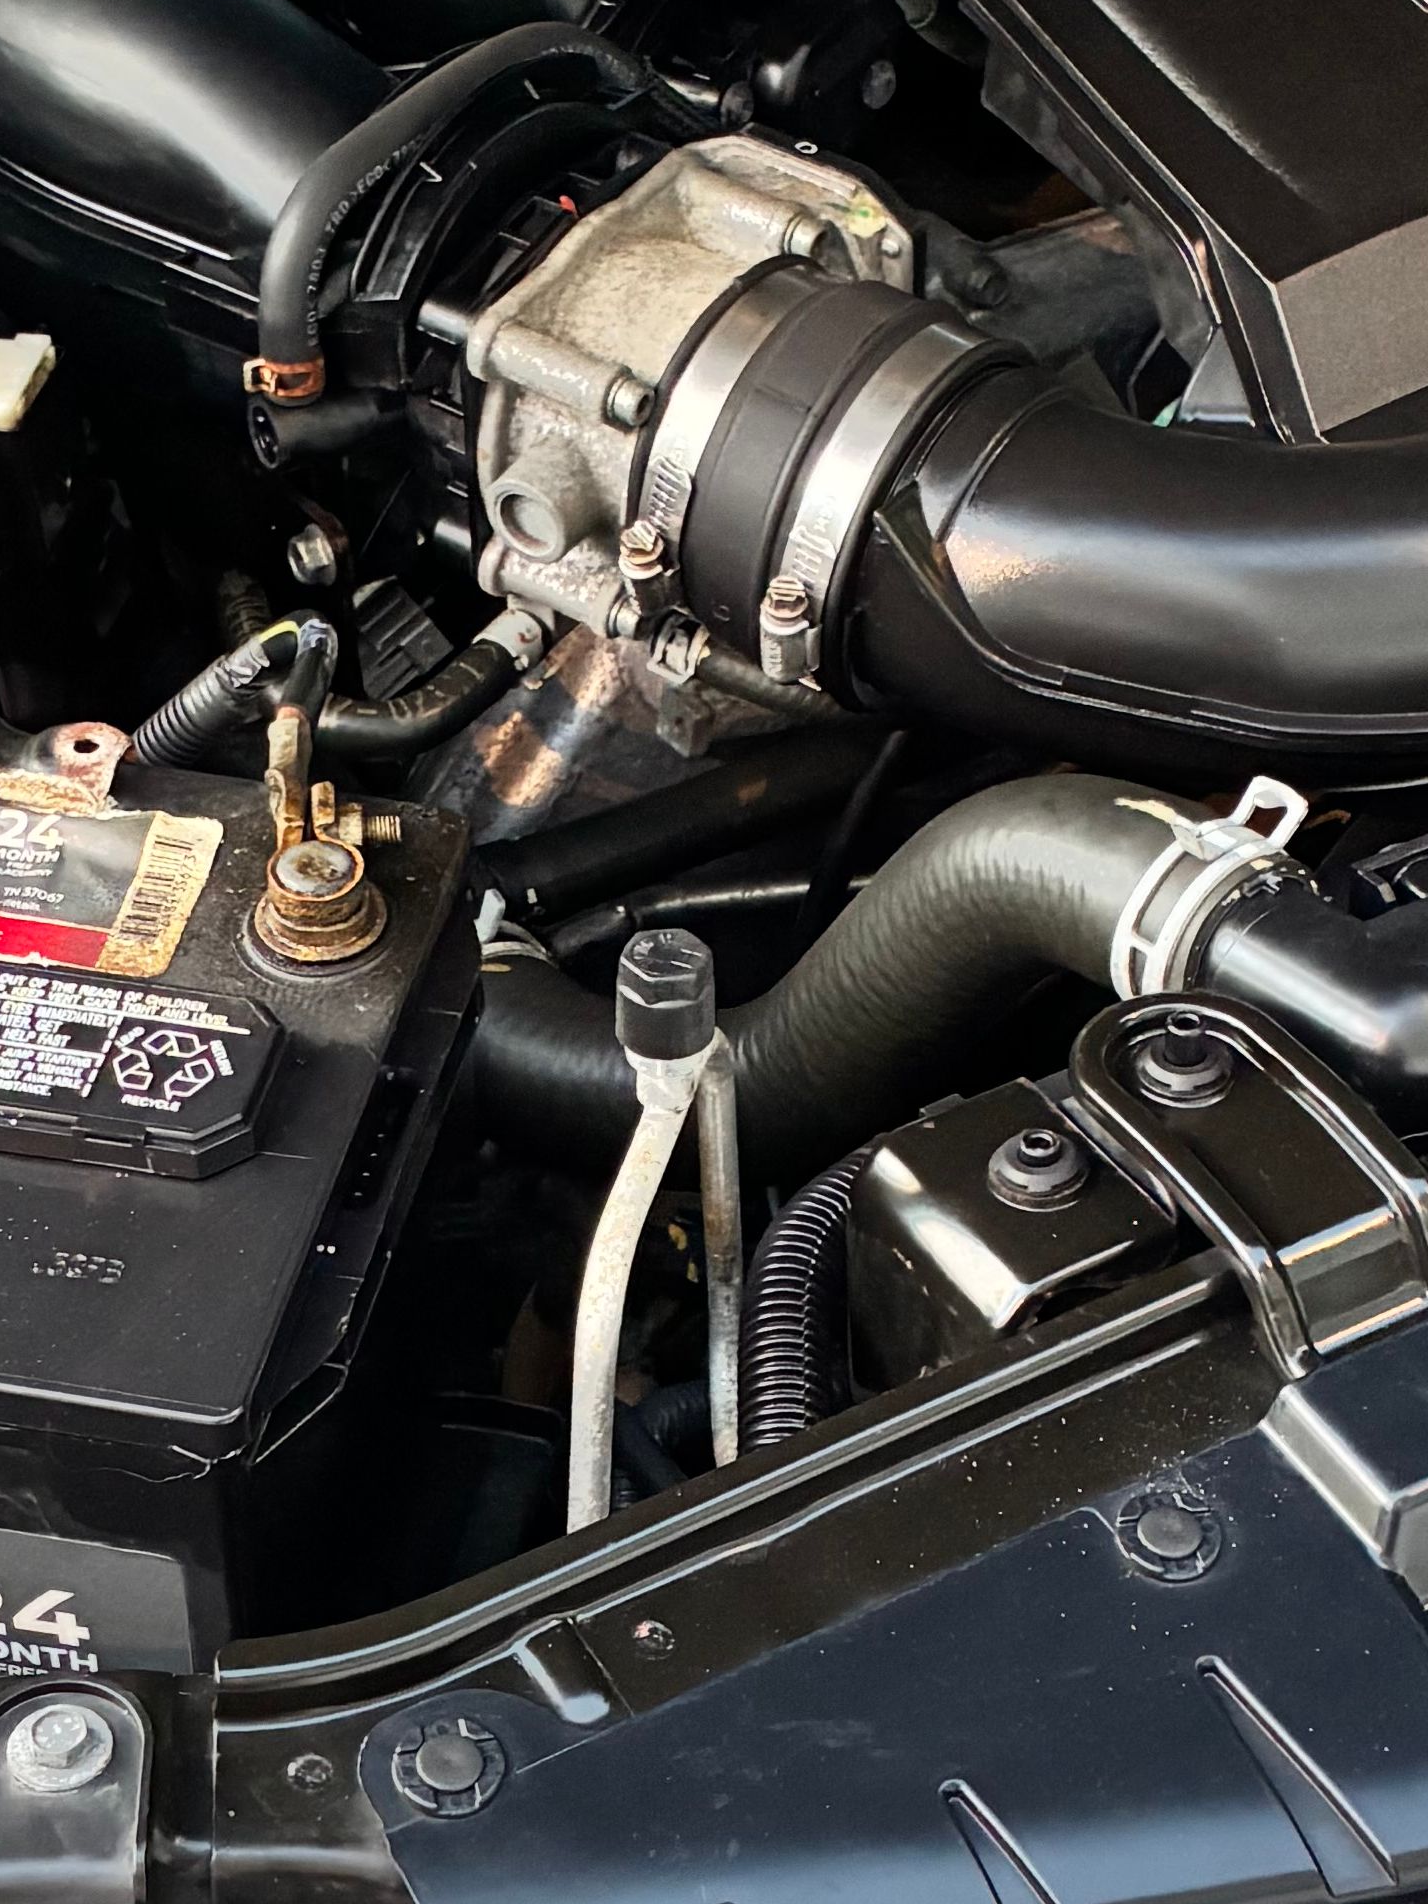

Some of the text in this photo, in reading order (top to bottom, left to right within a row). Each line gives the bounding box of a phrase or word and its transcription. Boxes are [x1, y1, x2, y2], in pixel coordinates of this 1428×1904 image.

[3, 886, 22, 897] TN
[22, 885, 65, 904] 37067
[10, 985, 46, 999] KEEP
[47, 989, 80, 1004] VENT
[82, 996, 118, 1010] CAPS
[121, 1000, 161, 1016] TIGHT
[160, 1007, 190, 1020] AND
[28, 976, 50, 989] OF
[50, 979, 78, 994] THE
[78, 984, 122, 1001] REACH
[123, 991, 145, 1002] OF
[144, 993, 209, 1013] CHILDREN
[0, 1000, 36, 1016] EYES
[34, 1004, 118, 1028] IMMEDIATELY
[33, 1019, 64, 1034] GET
[1, 1027, 37, 1043] HELP
[36, 1032, 72, 1047] FAST
[34, 1049, 92, 1068] STARTING
[120, 1093, 182, 1113] RECYCLE
